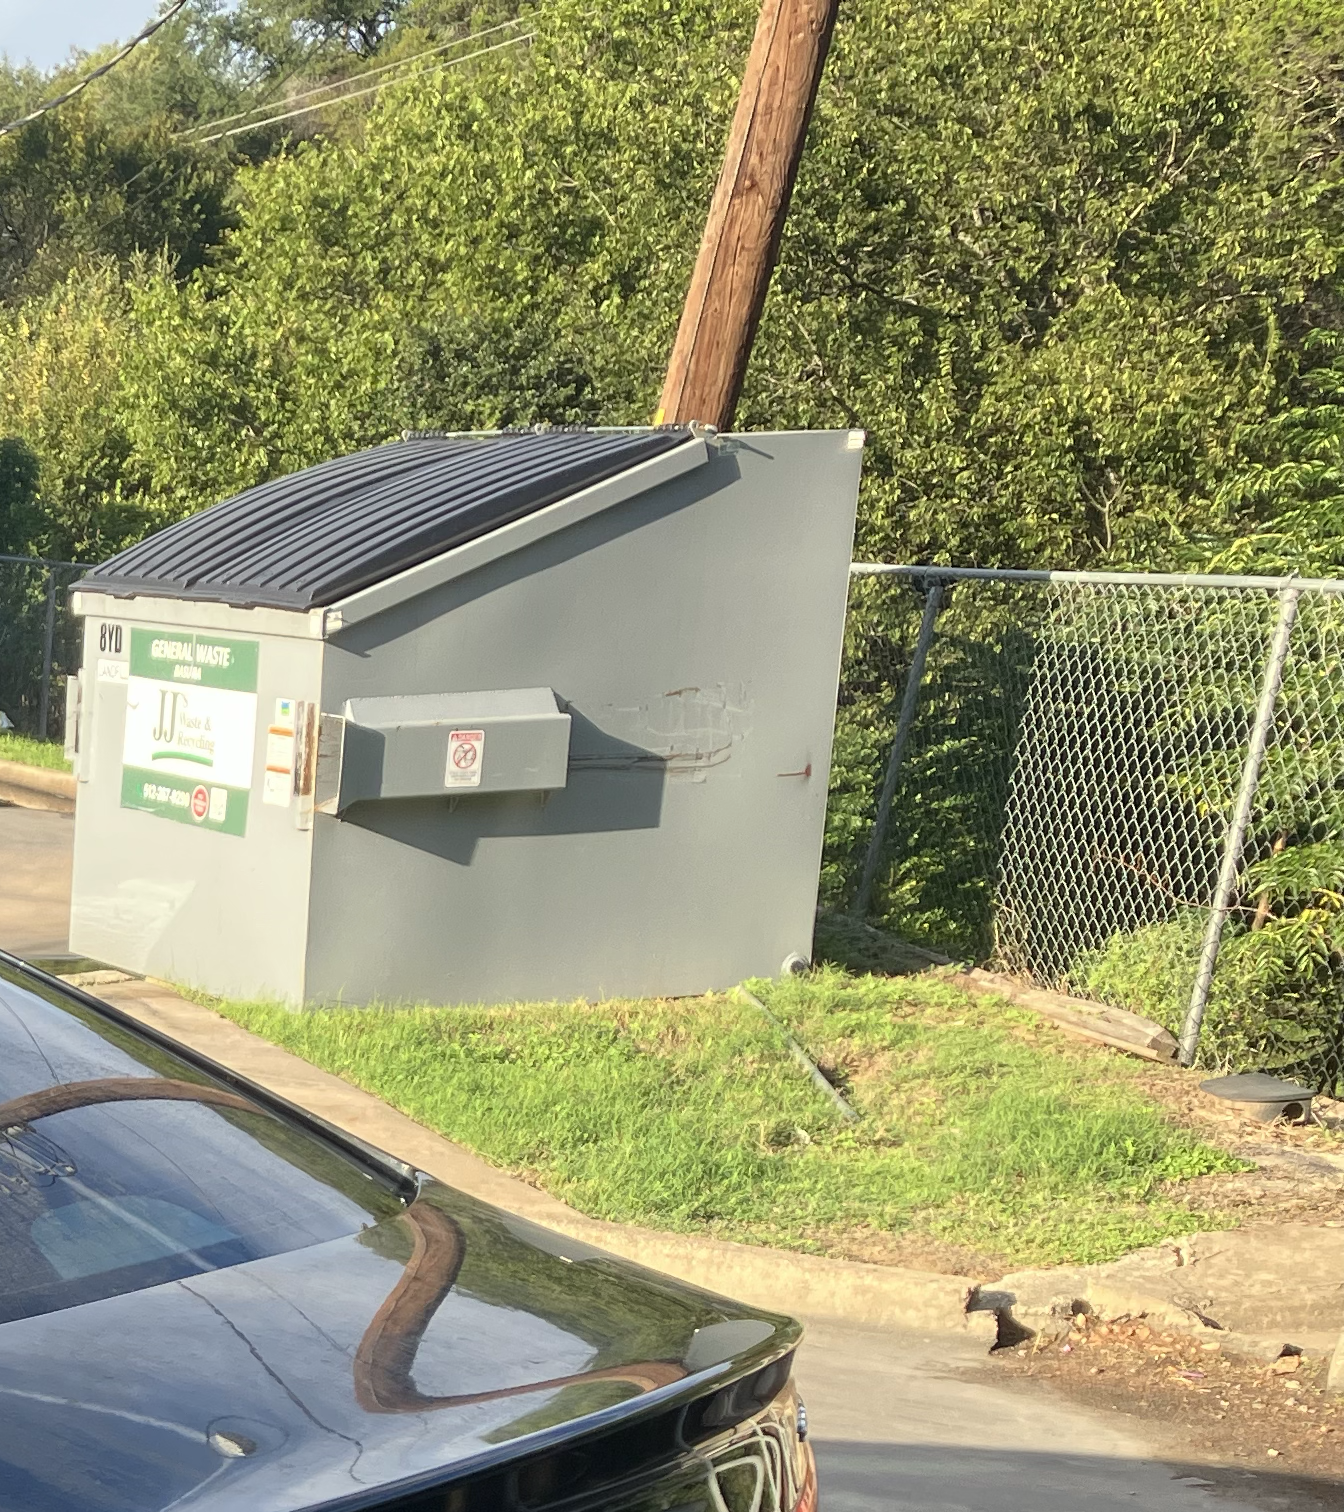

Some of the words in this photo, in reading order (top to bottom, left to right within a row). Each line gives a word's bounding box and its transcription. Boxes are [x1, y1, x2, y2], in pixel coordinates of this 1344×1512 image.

[99, 622, 123, 654] 8YD
[151, 639, 194, 662] GENERAL
[196, 644, 232, 667] WASTE
[179, 712, 202, 730] Waste
[204, 716, 212, 731] &
